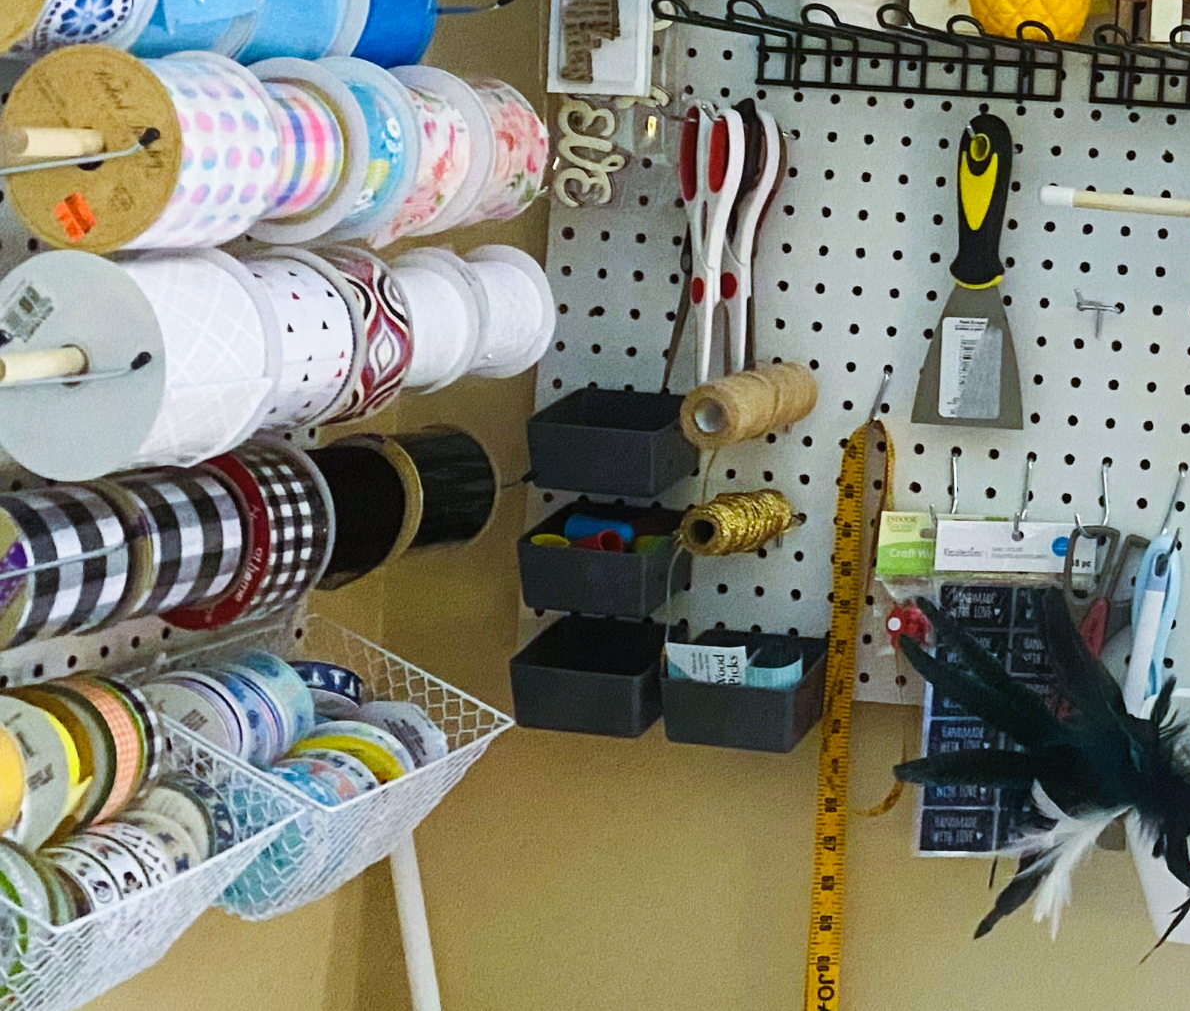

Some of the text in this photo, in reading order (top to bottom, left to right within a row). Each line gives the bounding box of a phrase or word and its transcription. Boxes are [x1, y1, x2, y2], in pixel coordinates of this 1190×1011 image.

[889, 548, 915, 558] Craft
[727, 654, 740, 686] Picks
[822, 835, 837, 852] 57
